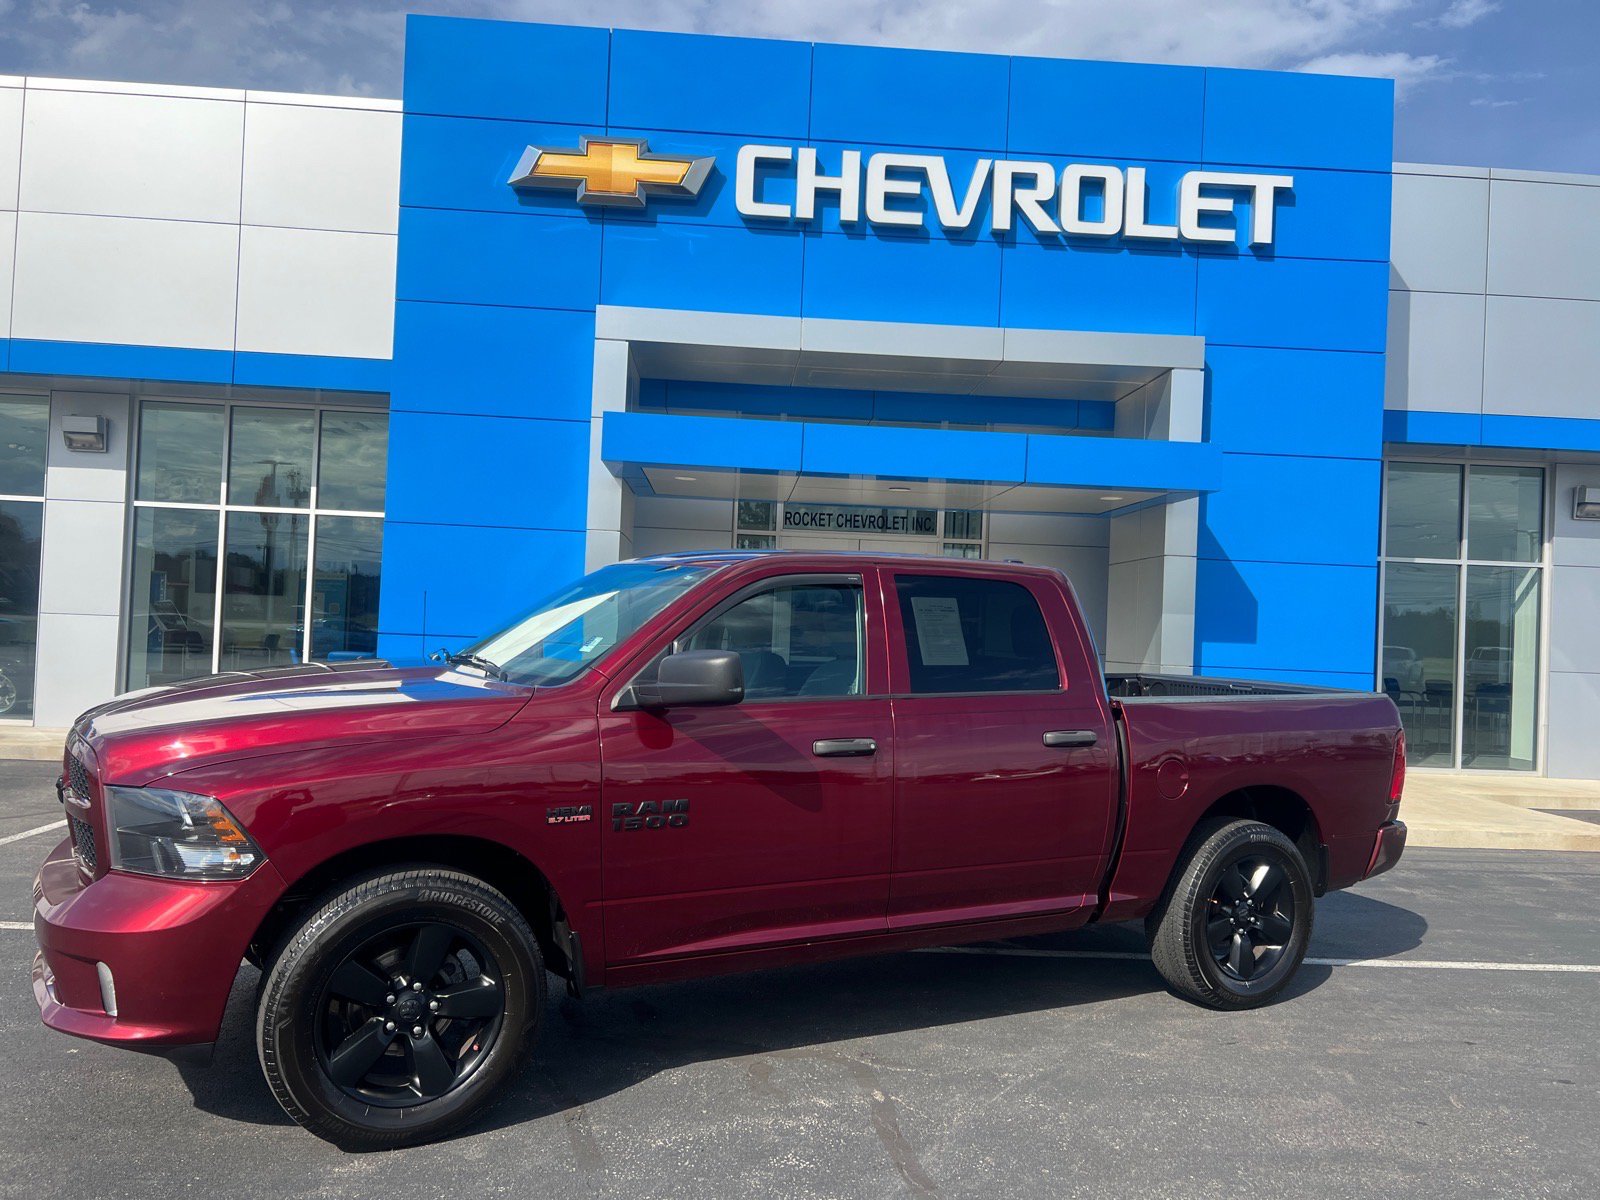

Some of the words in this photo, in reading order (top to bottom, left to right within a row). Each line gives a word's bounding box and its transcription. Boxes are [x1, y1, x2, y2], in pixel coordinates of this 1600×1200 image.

[736, 144, 1294, 246] CHEVROLET
[784, 511, 833, 528] ROCKET
[912, 516, 935, 532] INC.
[546, 805, 592, 817] HEMI
[612, 799, 689, 815] RAM
[565, 814, 591, 822] LITER
[612, 814, 688, 832] 1500
[417, 889, 506, 925] BRIDGESTONE
